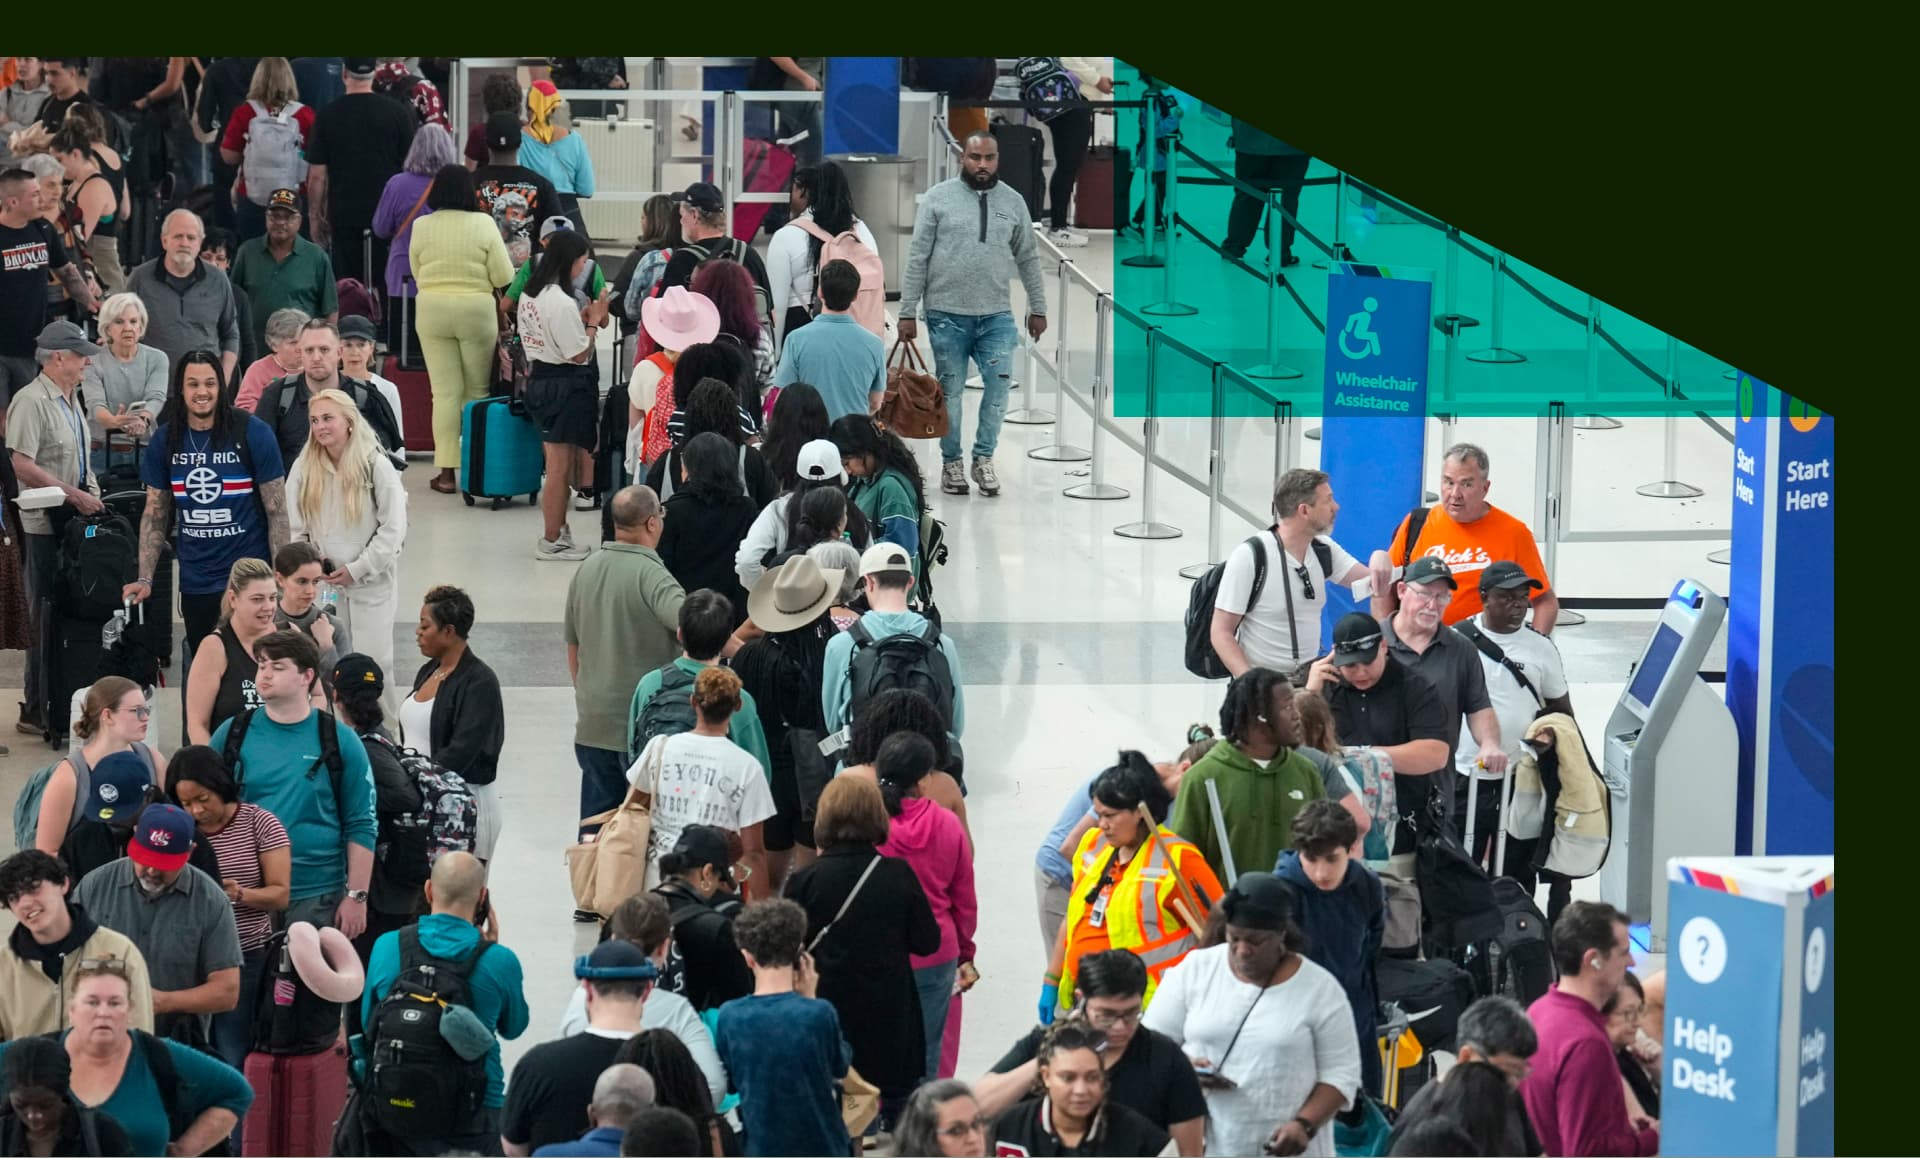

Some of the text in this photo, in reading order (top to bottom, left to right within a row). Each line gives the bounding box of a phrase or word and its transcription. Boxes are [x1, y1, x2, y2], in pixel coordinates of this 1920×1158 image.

[1335, 371, 1419, 392] Wheelchair
[1334, 392, 1409, 412] Assistance
[1737, 447, 1755, 476] Start
[1786, 459, 1830, 483] Start
[1736, 477, 1754, 506] Here
[1785, 490, 1829, 512] Here
[1673, 1016, 1734, 1066] Help
[1801, 1027, 1826, 1066] Help
[1672, 1057, 1737, 1102] Desk
[1799, 1065, 1826, 1107] Desk
